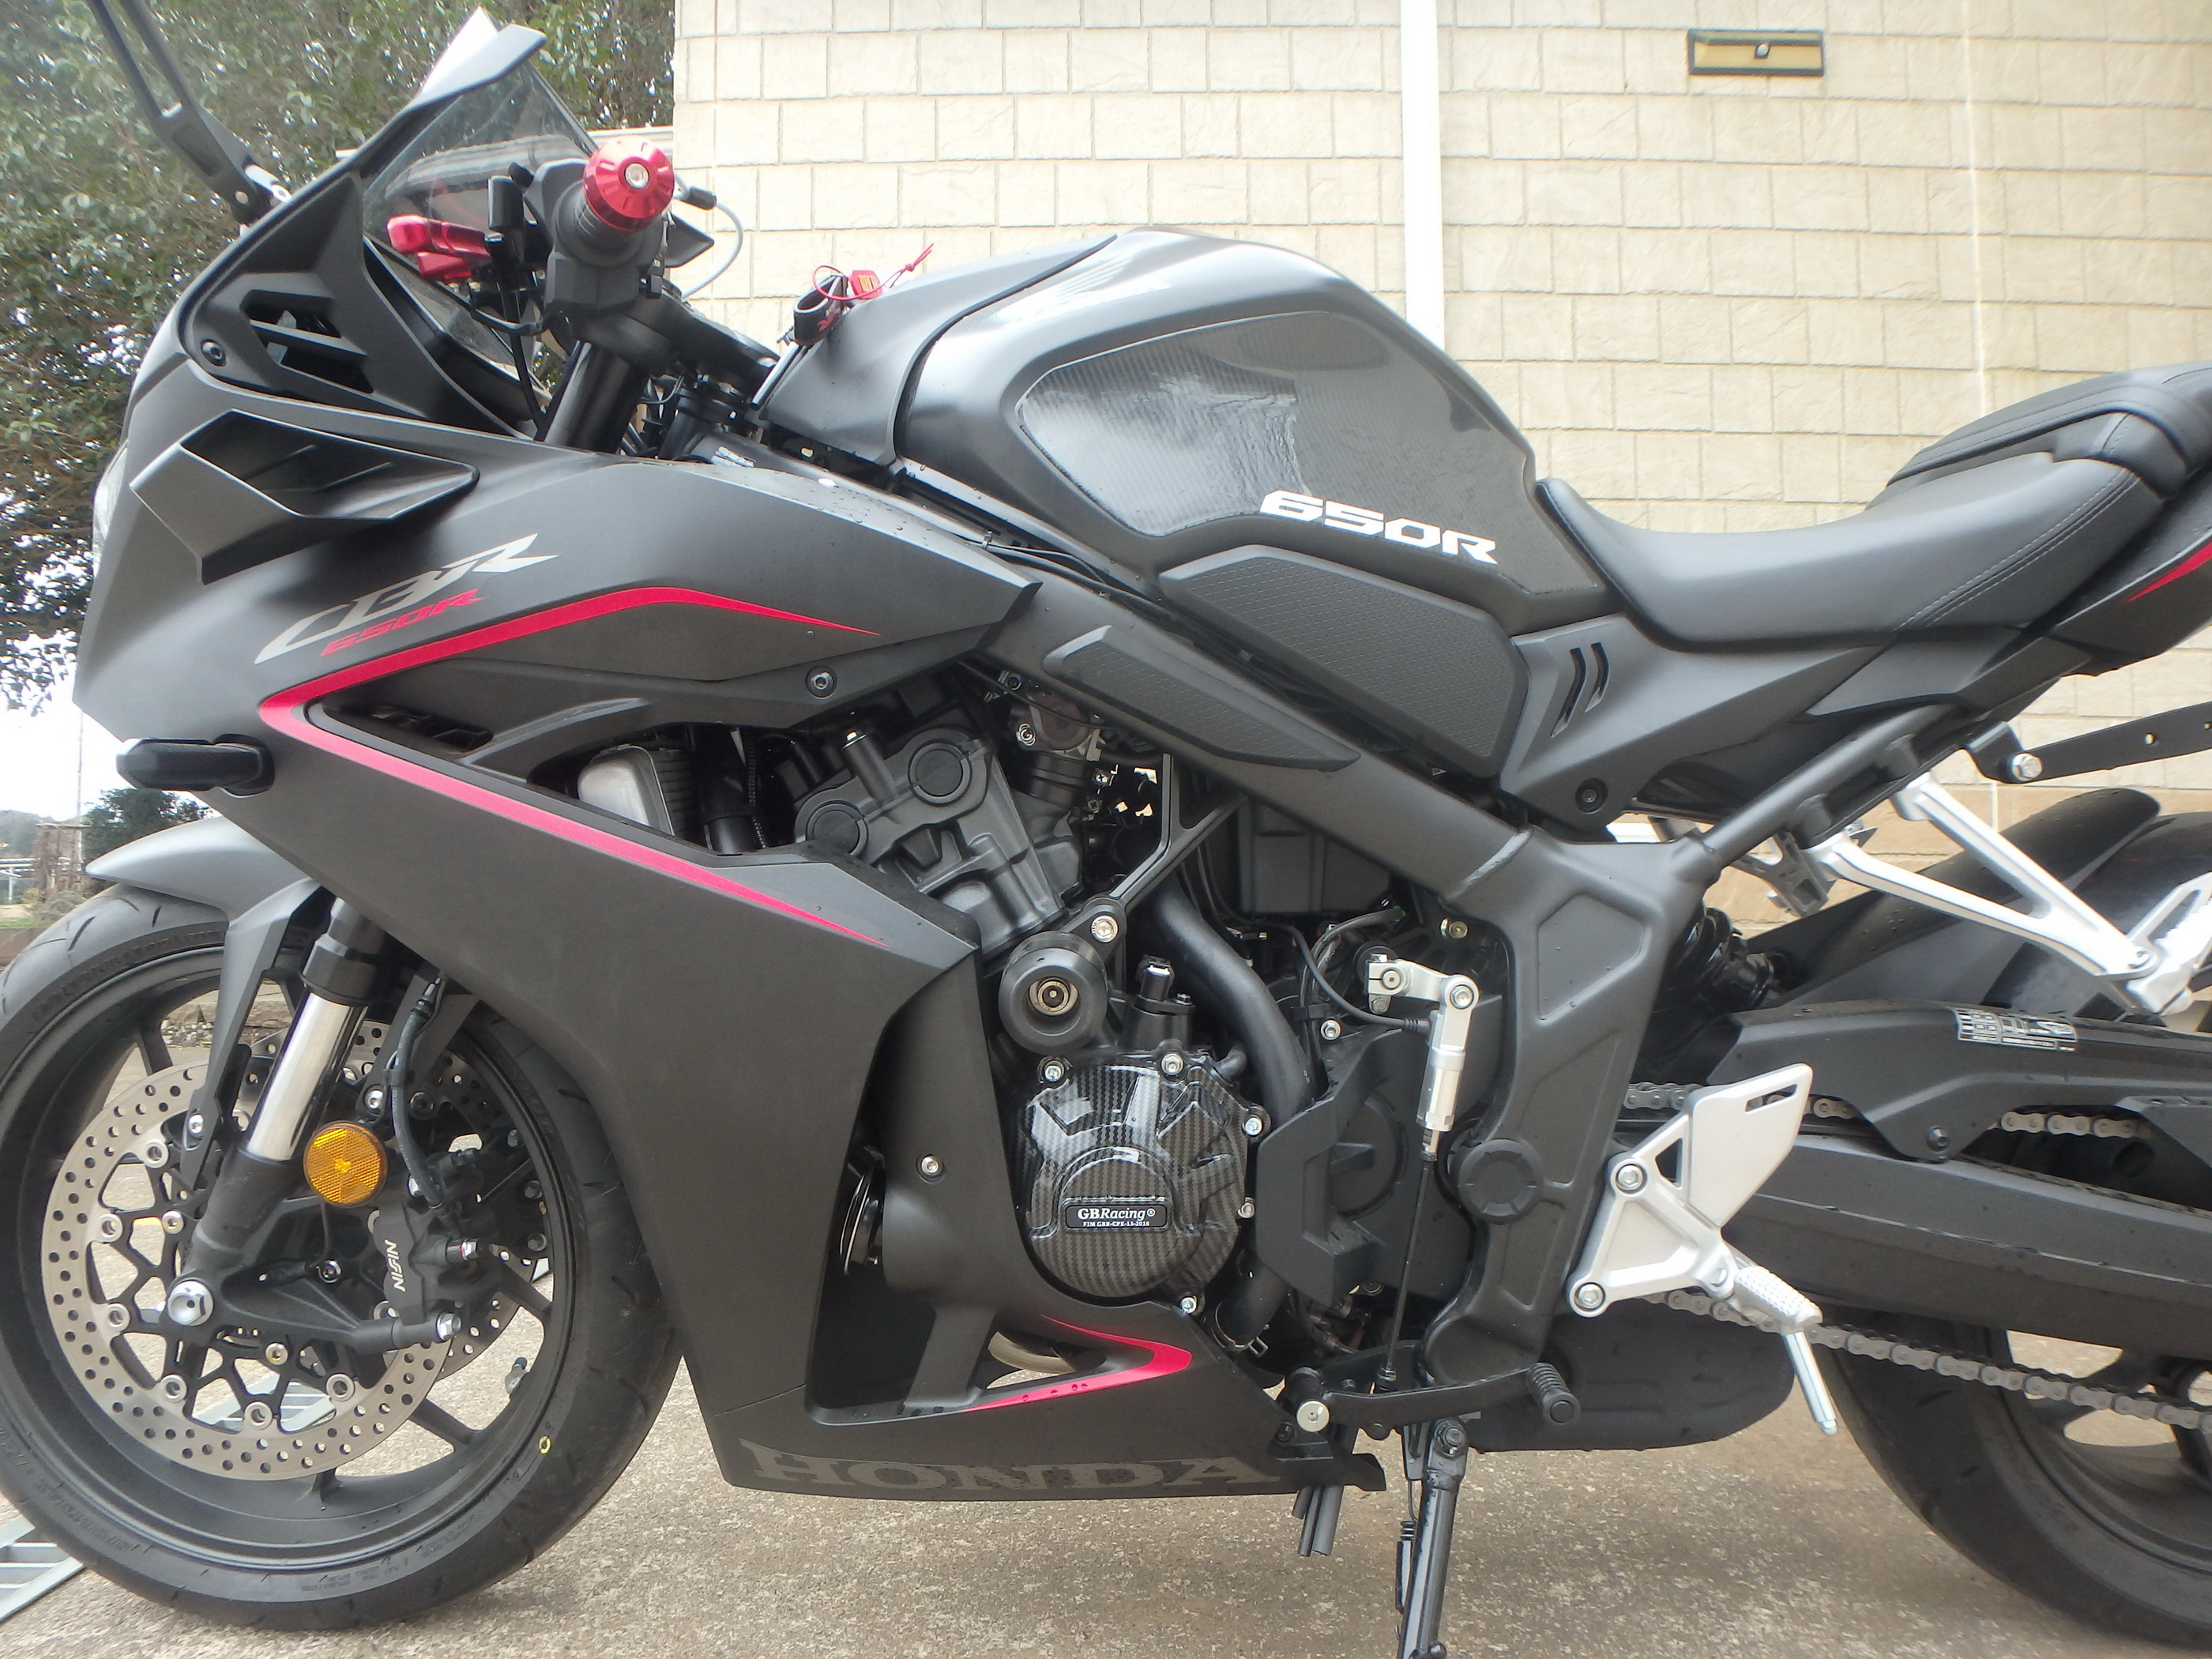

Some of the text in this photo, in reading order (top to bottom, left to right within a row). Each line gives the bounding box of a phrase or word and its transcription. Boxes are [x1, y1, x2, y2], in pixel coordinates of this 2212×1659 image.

[1259, 489, 1498, 565] 650R
[254, 533, 559, 664] CBR
[321, 588, 483, 656] 650R
[739, 1437, 1281, 1491] HONDA
